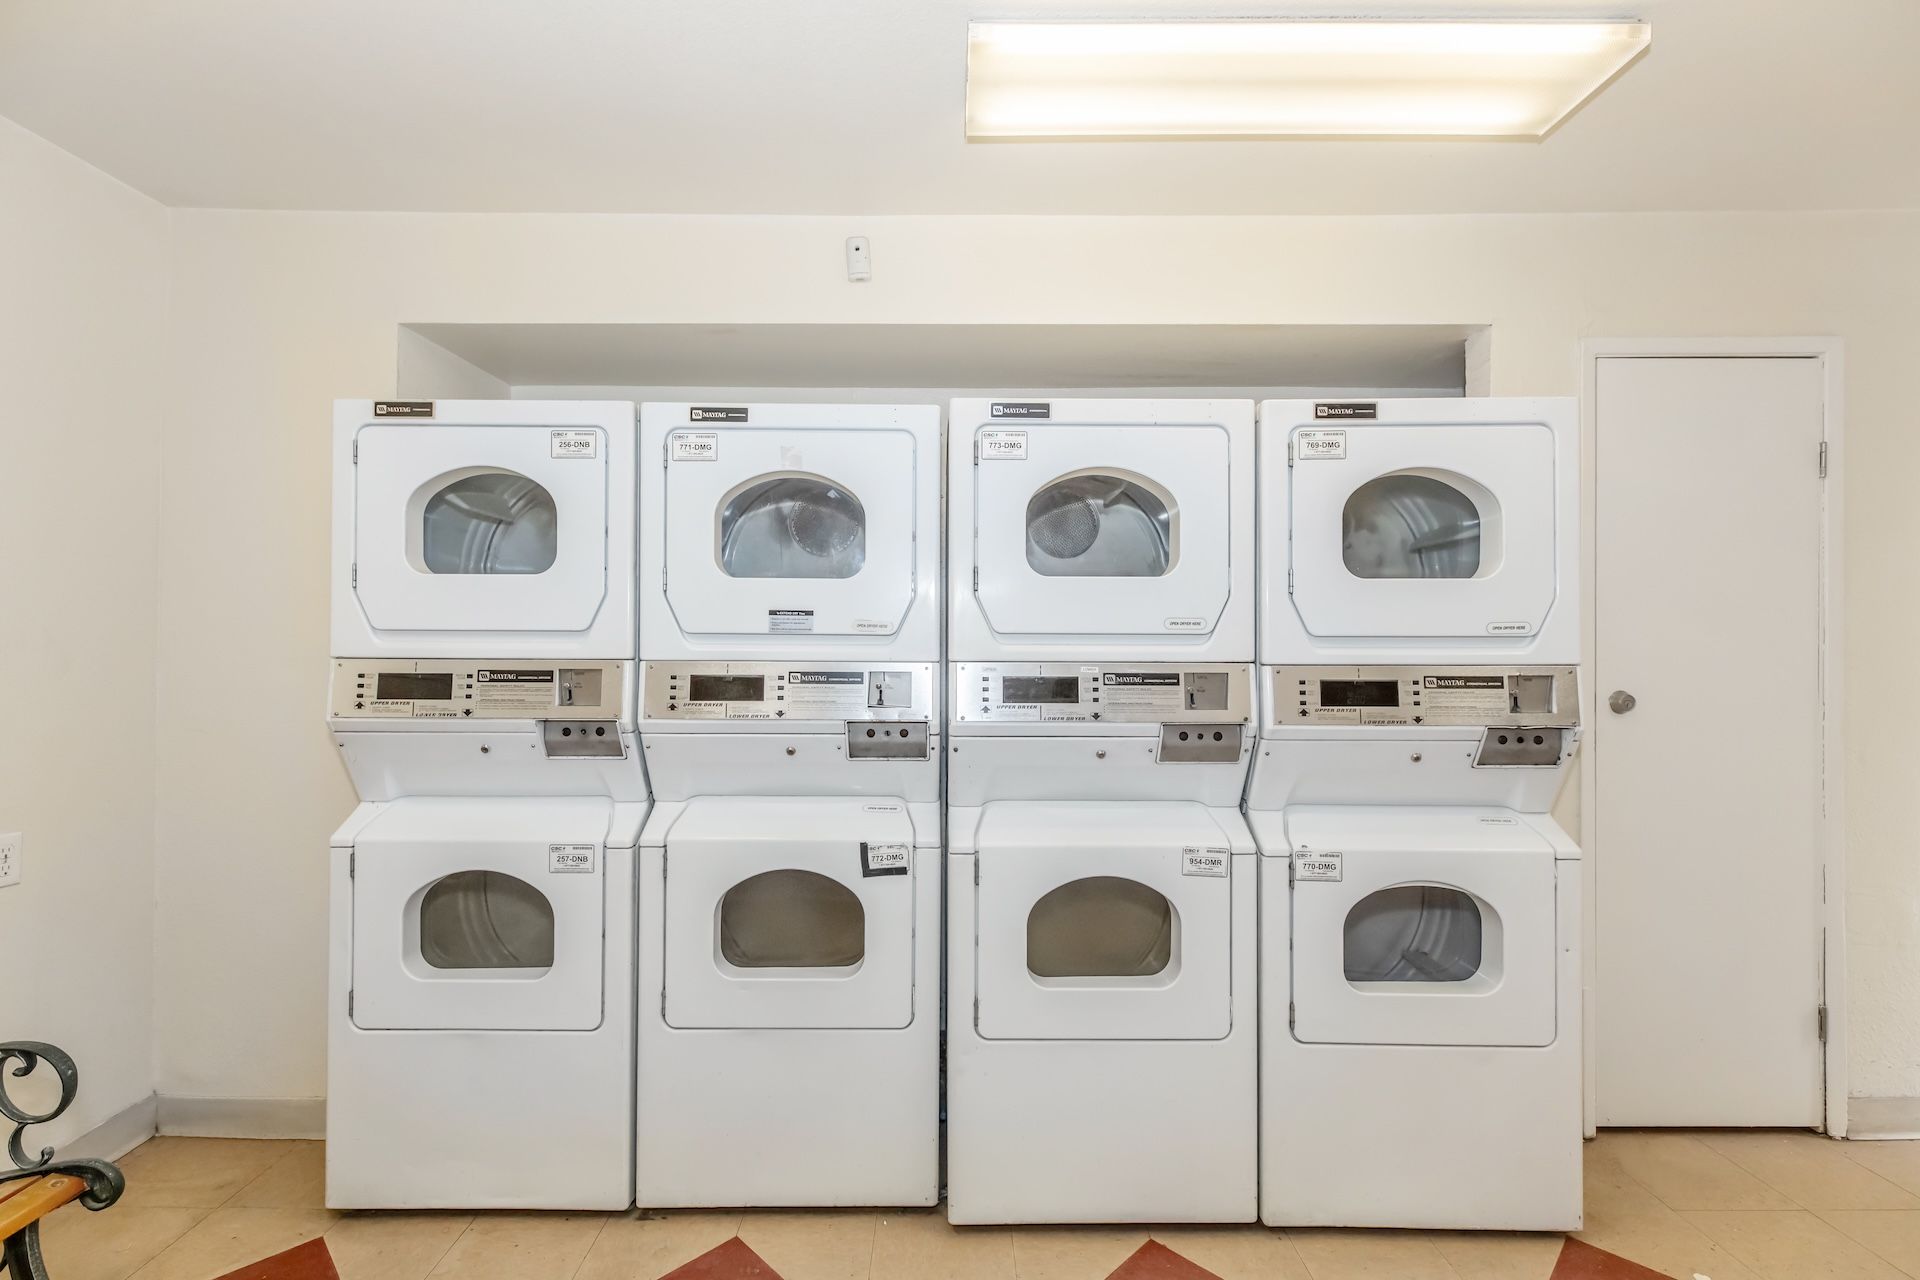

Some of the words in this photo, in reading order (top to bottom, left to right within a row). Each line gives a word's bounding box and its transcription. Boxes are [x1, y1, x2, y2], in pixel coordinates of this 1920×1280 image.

[679, 443, 712, 451] 771-DMG
[1306, 441, 1341, 449] 769-DMG
[871, 853, 904, 862] 772-DMG
[1189, 857, 1222, 866] 954-DMR
[1303, 863, 1337, 871] 770-DMG
